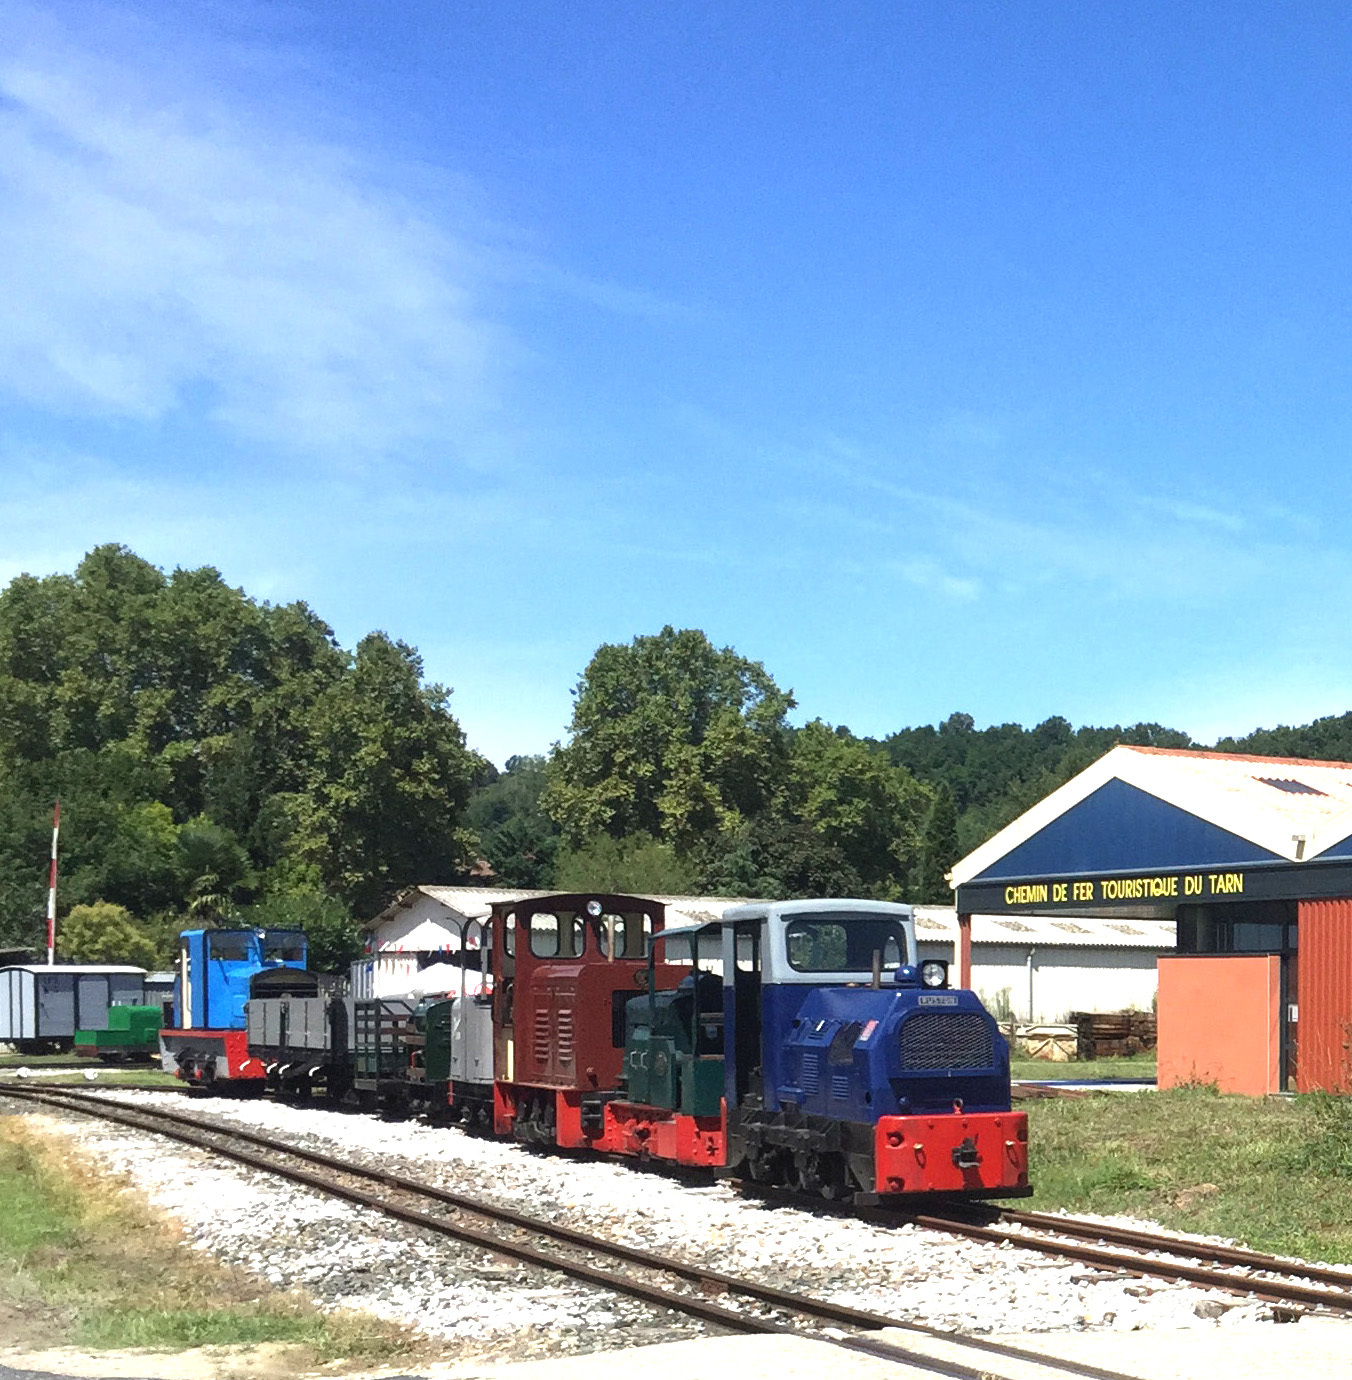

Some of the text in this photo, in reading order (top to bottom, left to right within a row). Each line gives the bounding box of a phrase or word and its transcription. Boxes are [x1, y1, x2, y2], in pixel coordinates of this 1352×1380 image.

[1005, 874, 1243, 904] CHEMIN DE FER TOURISTIQUE DU TARN
